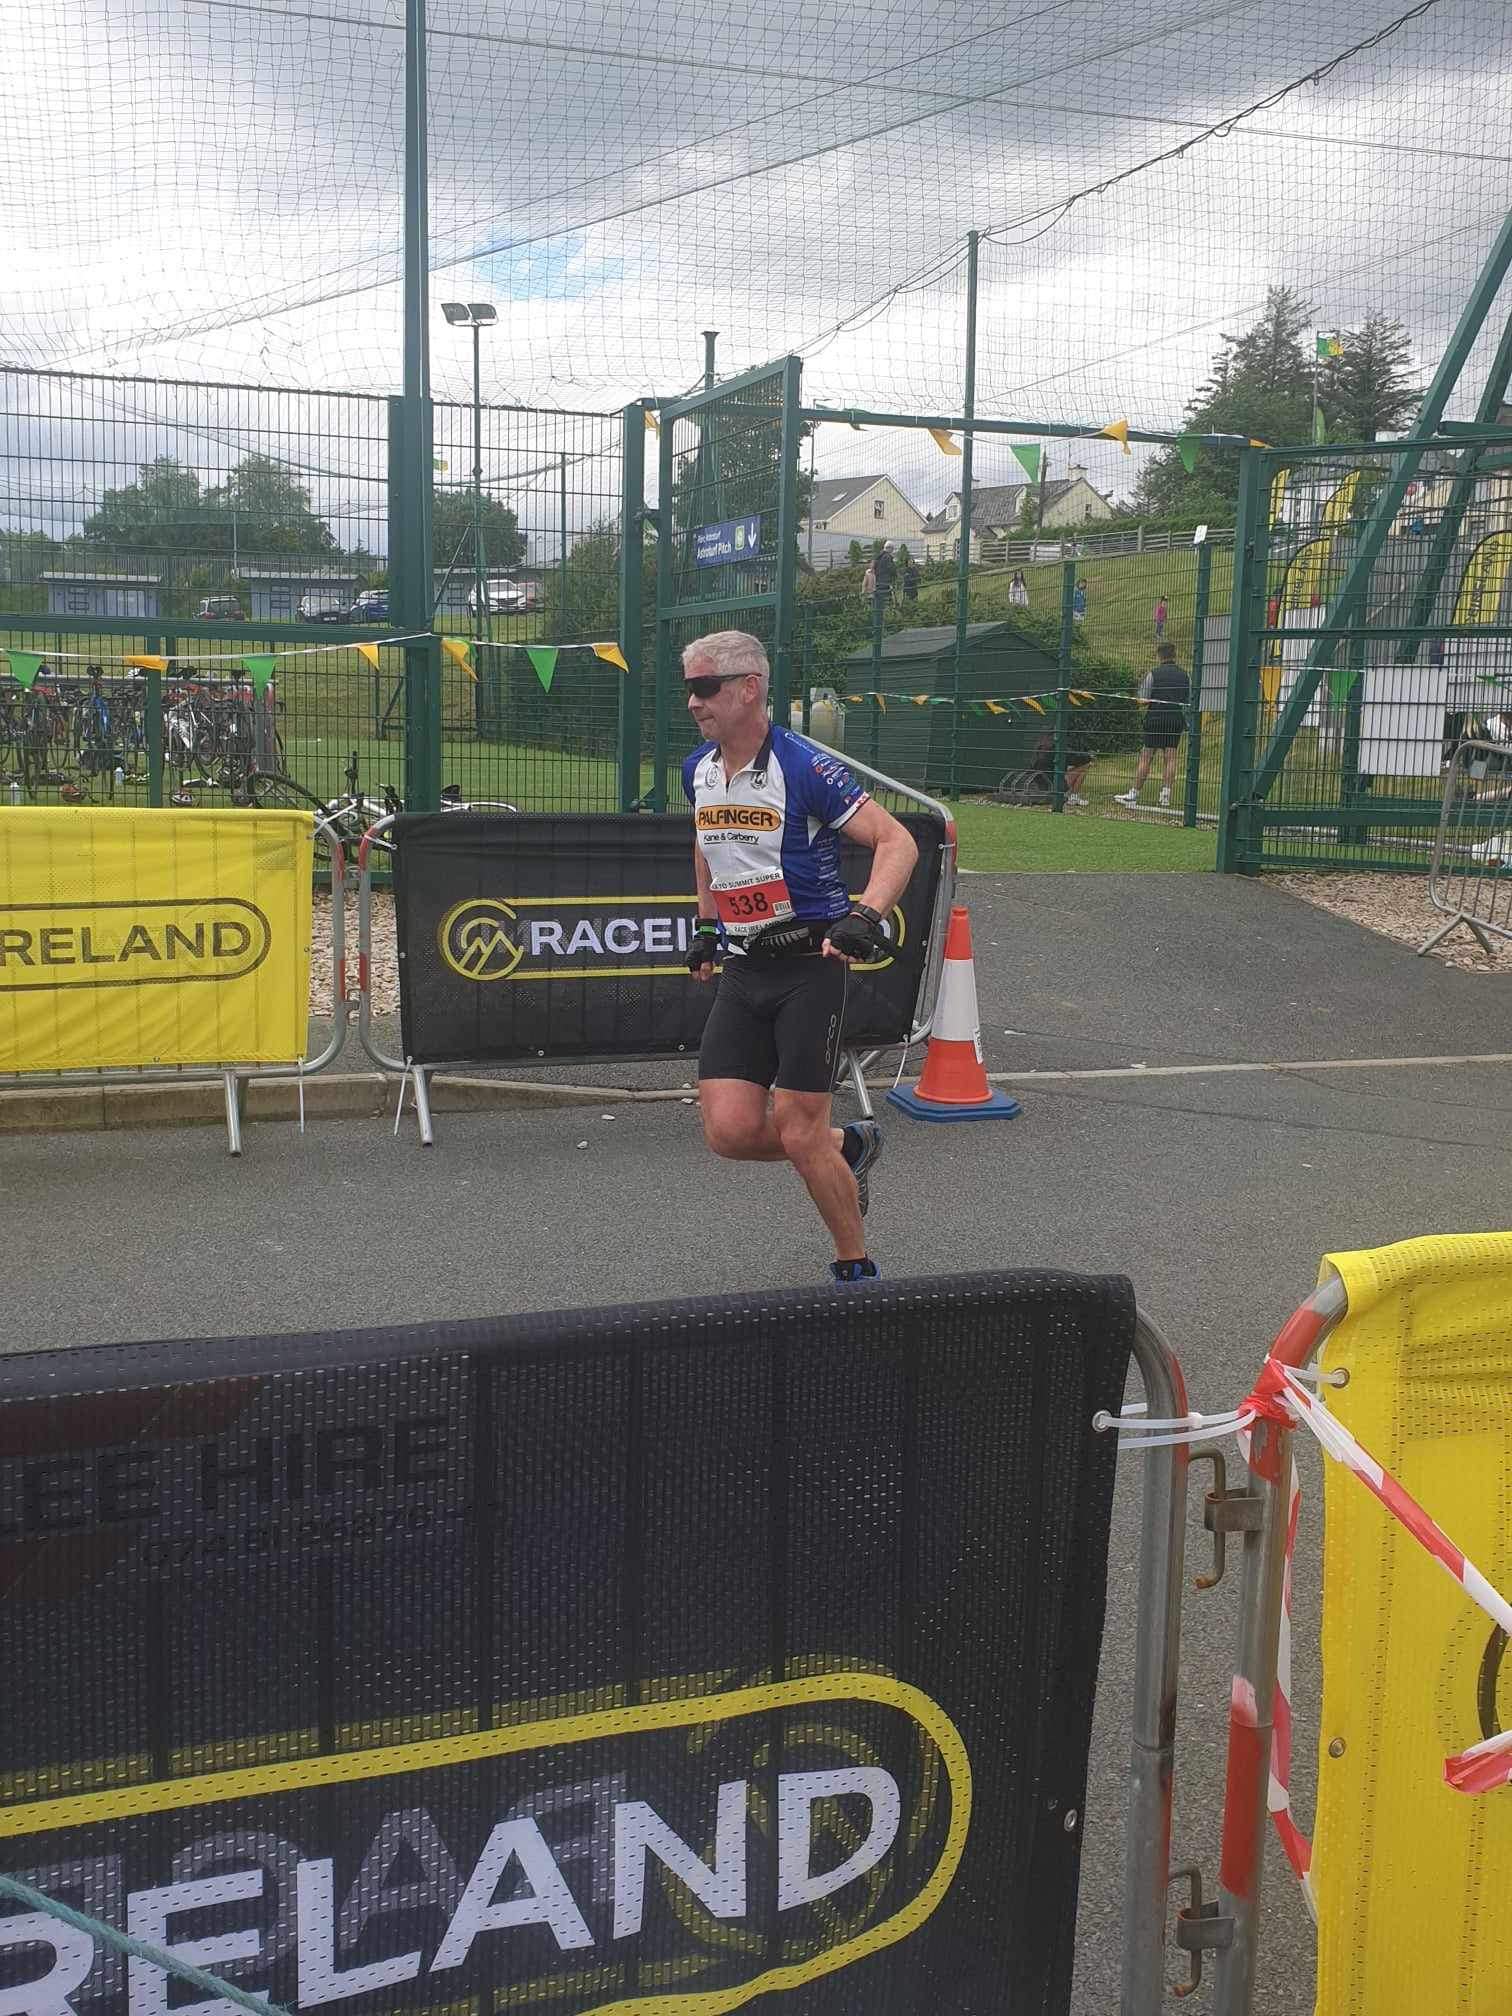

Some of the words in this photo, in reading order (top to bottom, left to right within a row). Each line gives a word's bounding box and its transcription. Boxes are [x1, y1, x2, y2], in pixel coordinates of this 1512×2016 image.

[698, 808, 773, 827] PALFINGER
[727, 832, 760, 845] Carberry
[728, 878, 754, 889] SUMMIT
[755, 872, 781, 882] SUPER
[728, 892, 769, 916] 538
